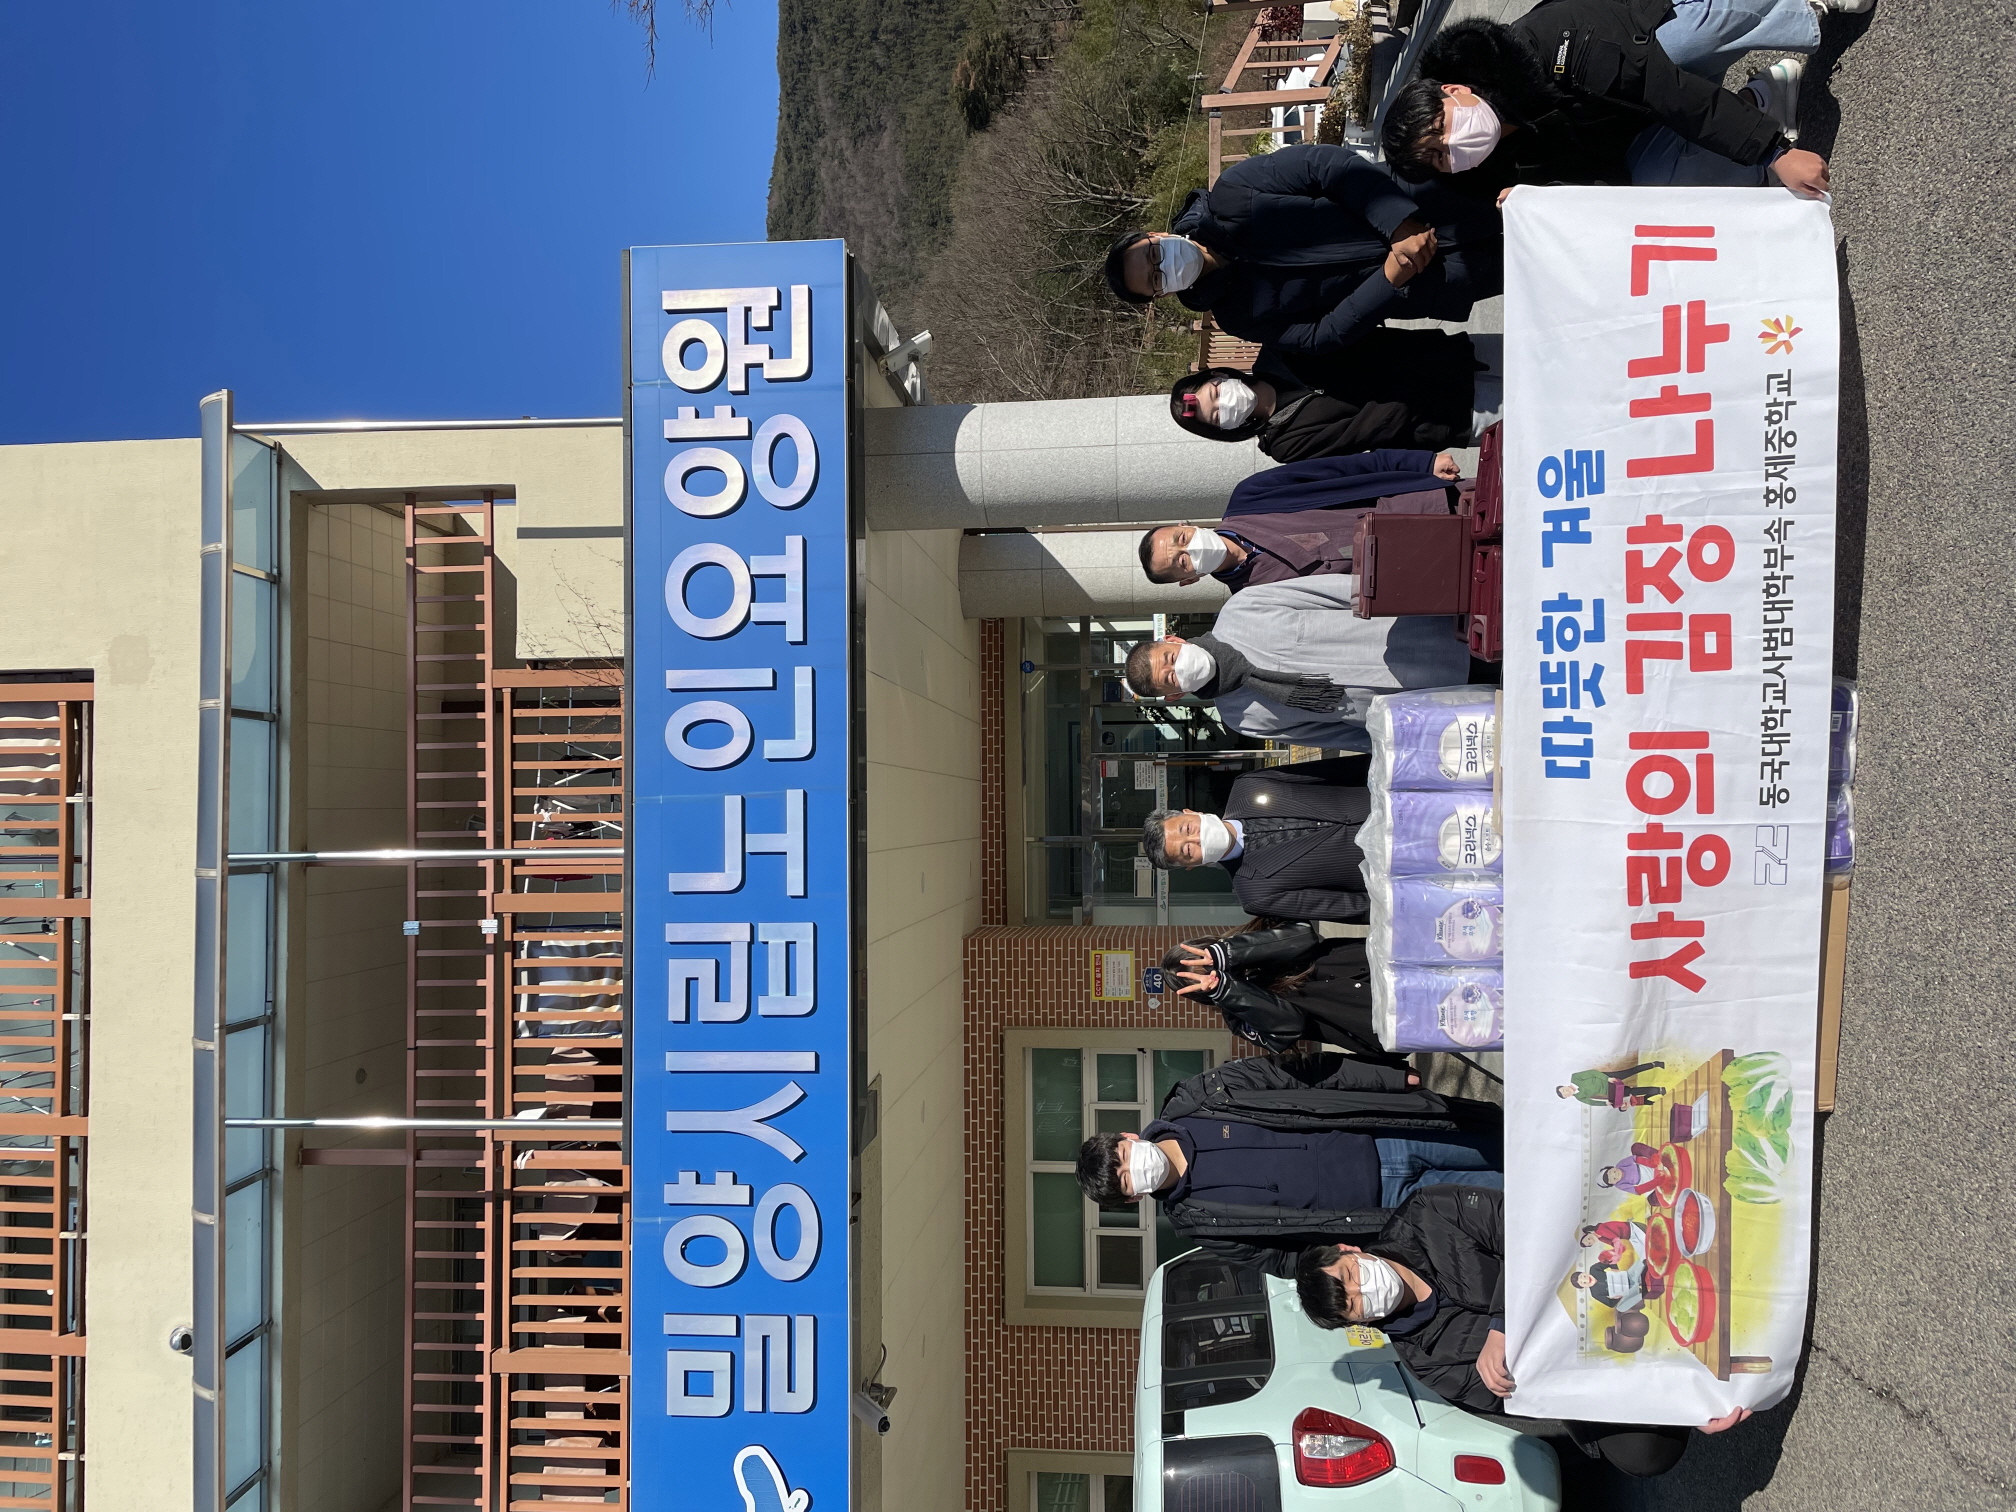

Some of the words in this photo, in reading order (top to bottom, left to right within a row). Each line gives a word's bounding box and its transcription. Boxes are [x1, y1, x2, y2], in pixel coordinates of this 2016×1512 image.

[1626, 225, 1730, 477] 나누기
[1762, 368, 1798, 509] 홍제중학교
[1537, 448, 1605, 568] 겨울
[1537, 592, 1606, 779] 따뜻한
[1625, 514, 1736, 695] 김장
[1758, 516, 1796, 809] 동국대학교사범대학부속
[1466, 721, 1478, 773] 크리넥스
[661, 285, 819, 1417] 밀양시립노인요양원
[1464, 814, 1477, 865] 크리넥스
[1625, 729, 1732, 994] 사랑의
[1154, 974, 1162, 988] 40
